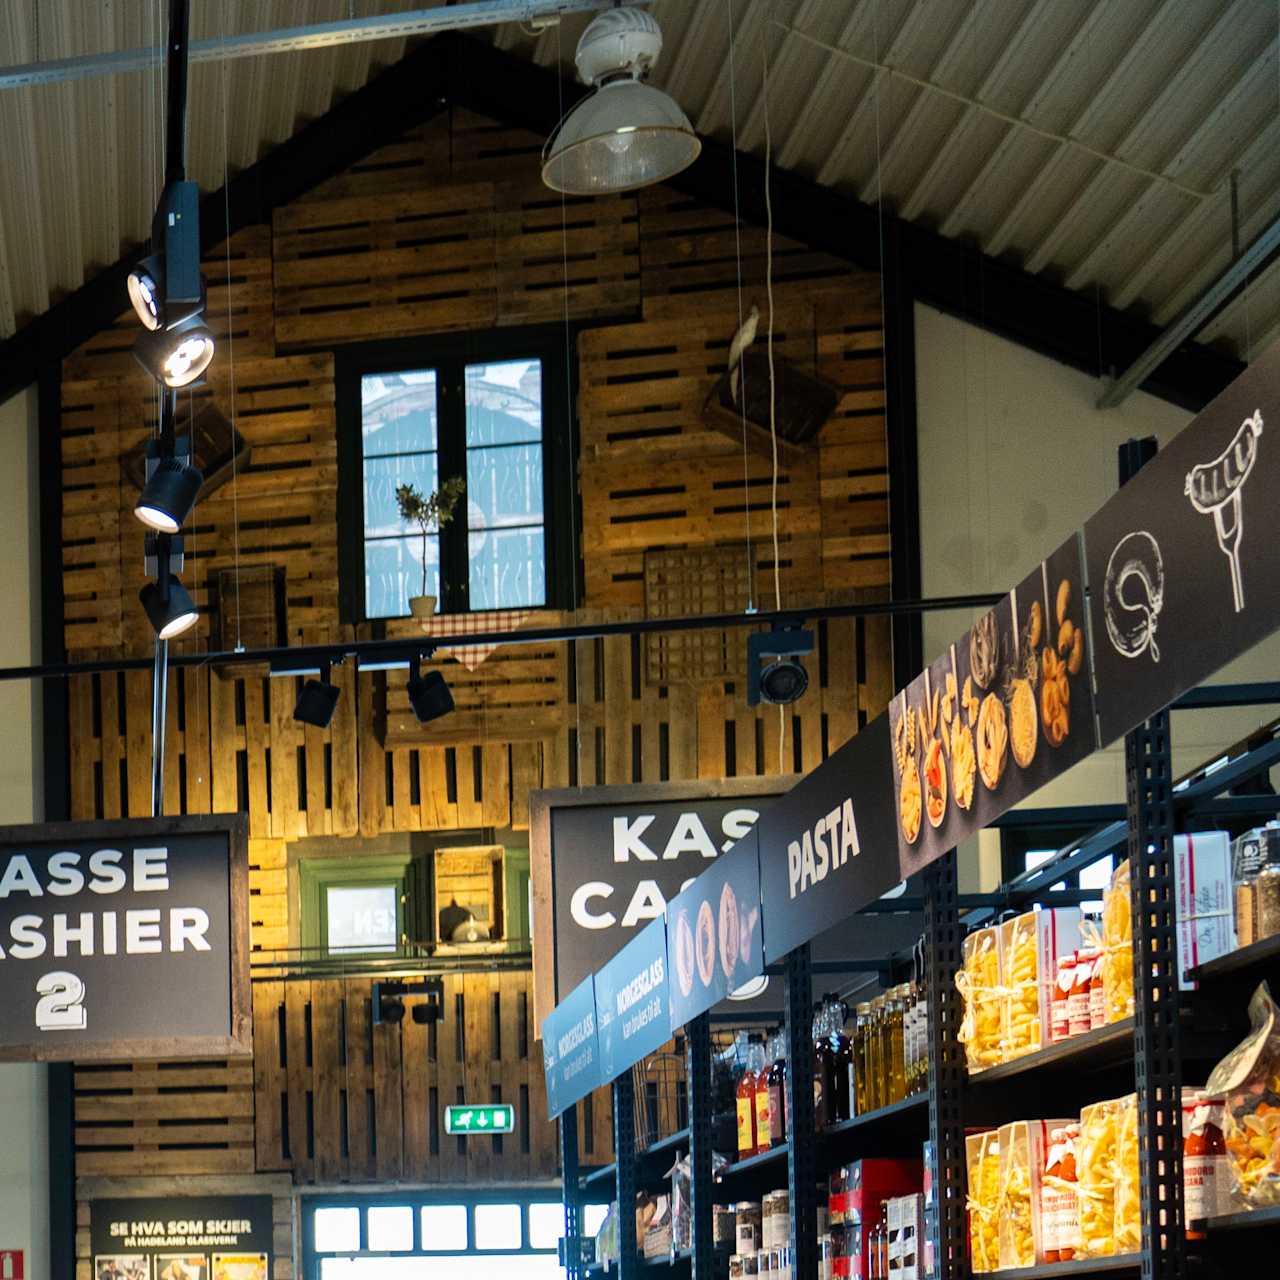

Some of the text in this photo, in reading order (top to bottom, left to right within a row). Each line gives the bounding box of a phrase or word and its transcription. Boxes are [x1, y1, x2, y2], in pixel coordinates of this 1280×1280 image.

[787, 798, 860, 899] PASTA
[569, 877, 698, 929] CA
[34, 970, 90, 1032] 2
[616, 956, 664, 1017] NORGESGLASS
[110, 1220, 252, 1237] SE HVA SOM SKJER
